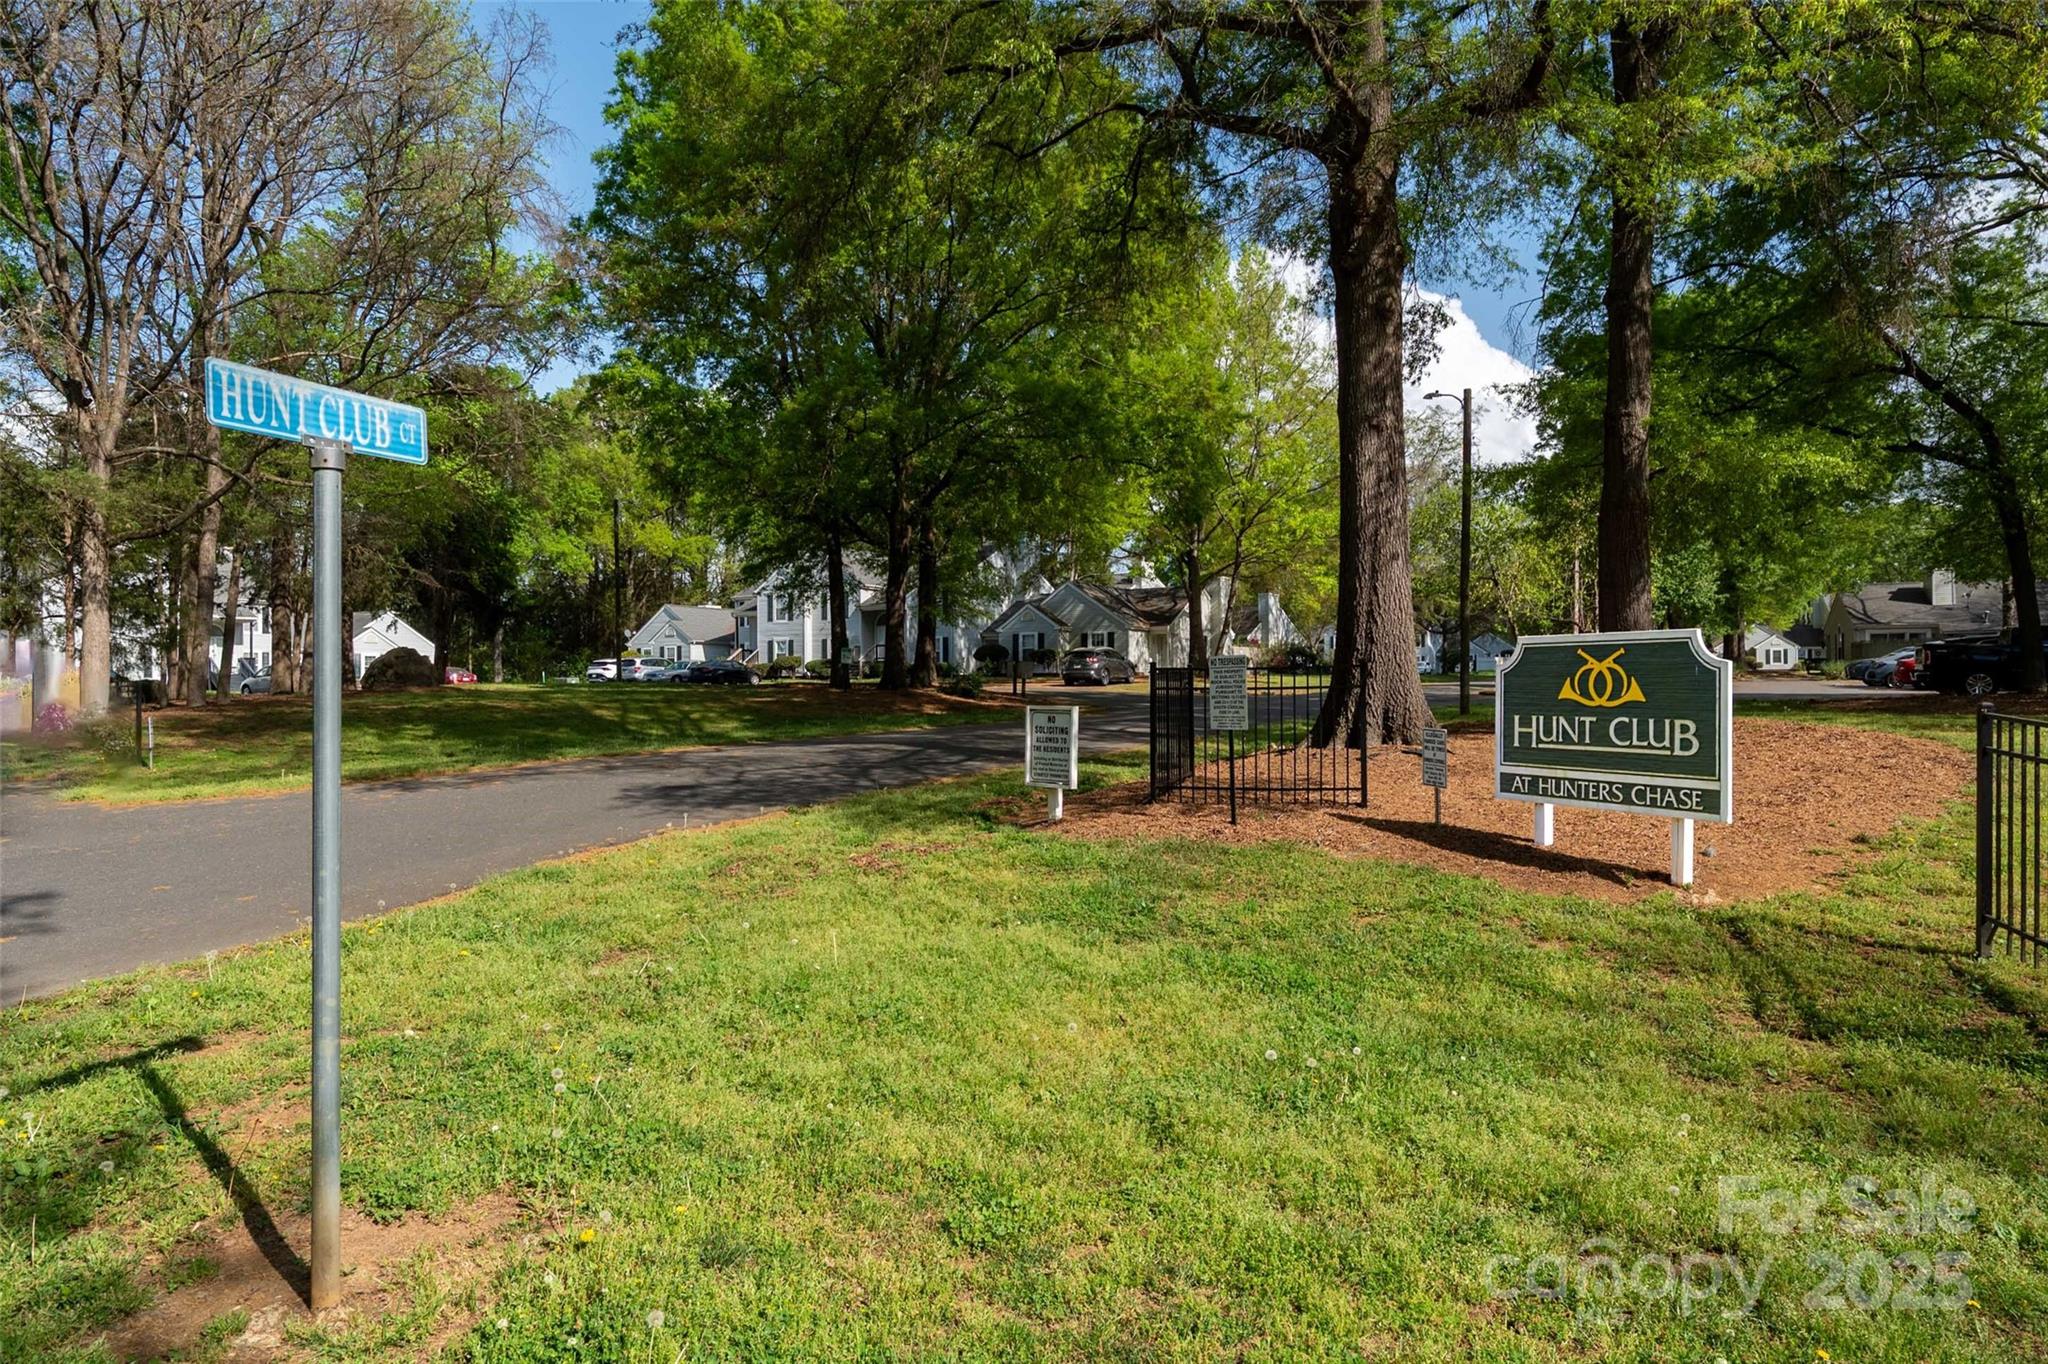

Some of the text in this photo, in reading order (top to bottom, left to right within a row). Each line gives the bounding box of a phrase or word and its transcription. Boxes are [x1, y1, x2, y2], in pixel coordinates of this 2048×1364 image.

[215, 367, 417, 449] HUNT CLUB CT
[1047, 715, 1056, 724] NO
[1034, 725, 1069, 735] SOLICITING
[1513, 714, 1700, 756] HUNT CLUB
[1036, 736, 1059, 744] ALLOWED
[1043, 745, 1070, 753] RESIDENTS
[1511, 776, 1704, 810] AT HUNTERS CHASE
